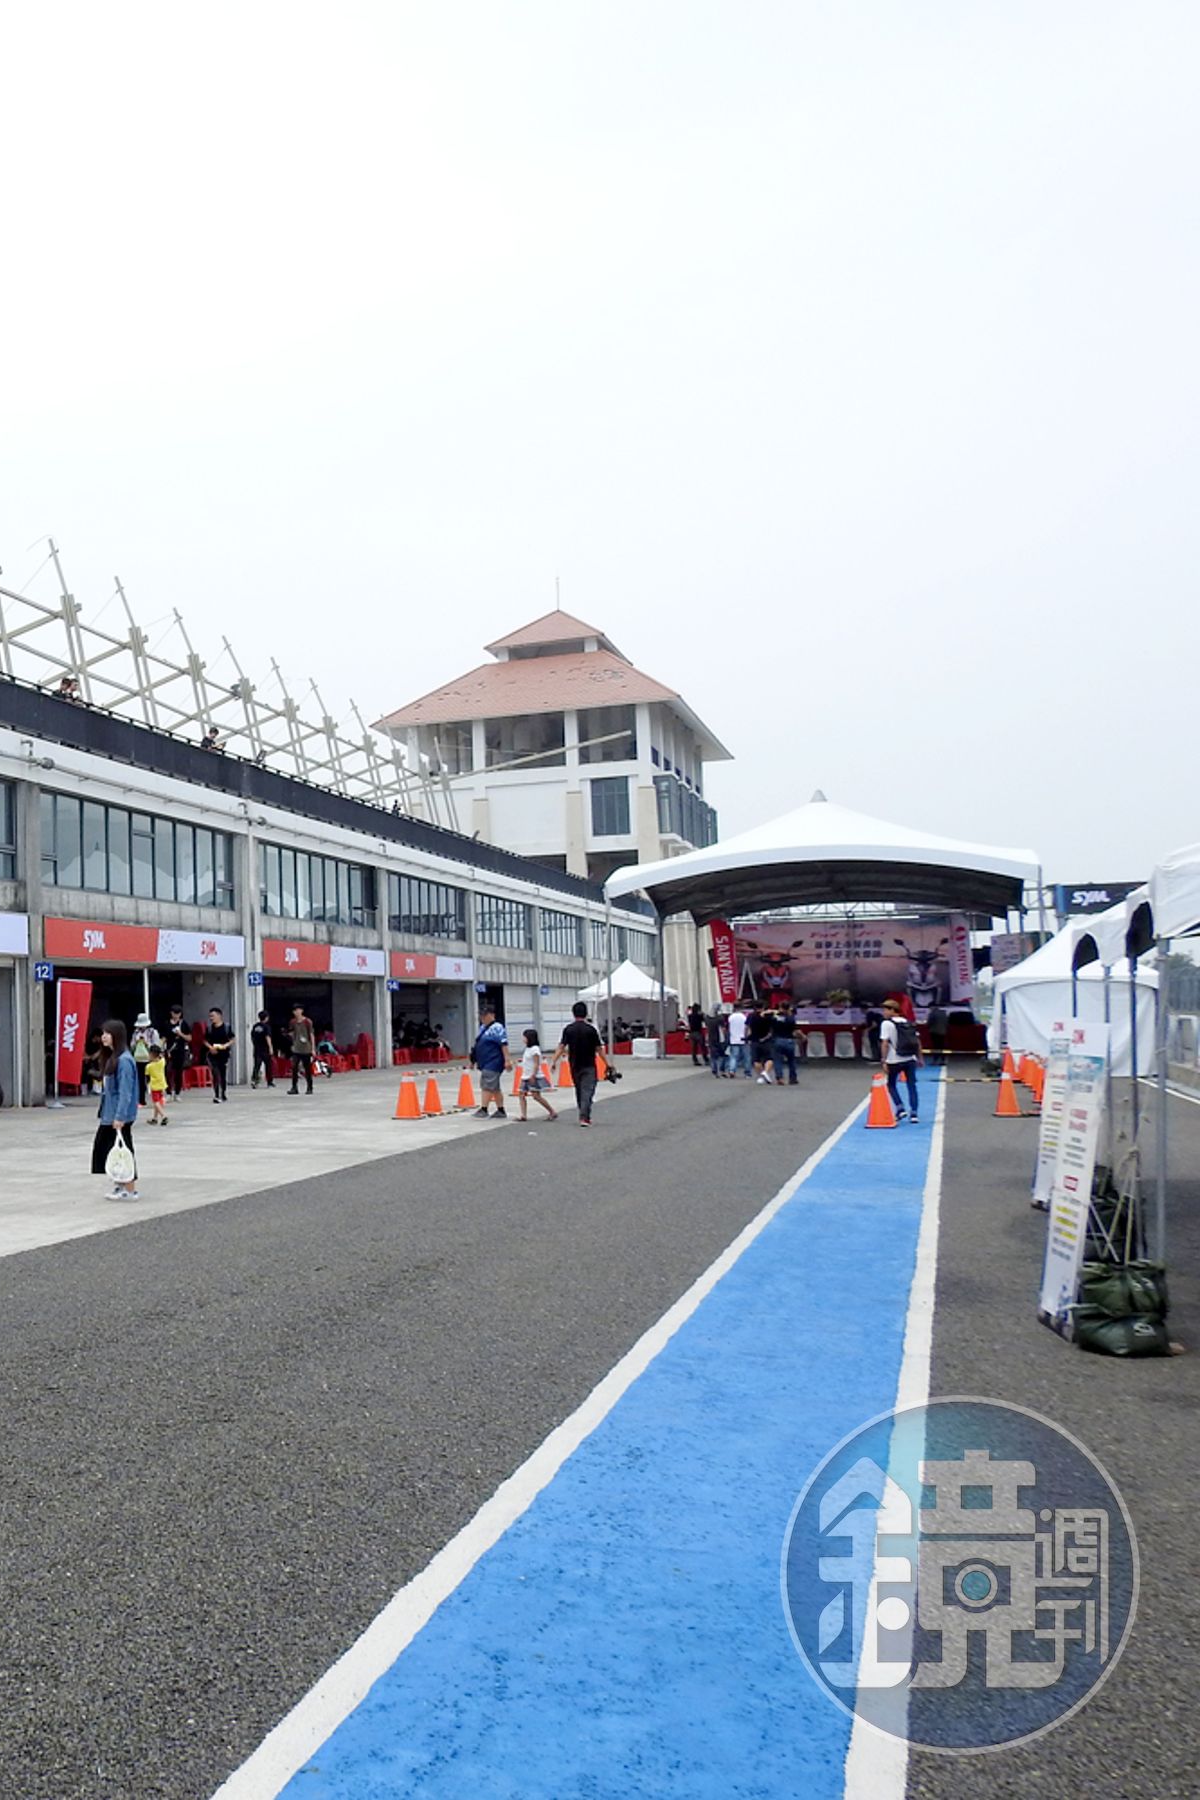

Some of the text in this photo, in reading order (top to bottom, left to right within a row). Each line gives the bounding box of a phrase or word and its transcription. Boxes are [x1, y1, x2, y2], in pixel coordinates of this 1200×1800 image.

[1071, 890, 1111, 906] SYM
[83, 929, 106, 953] SYM
[200, 940, 217, 959] SYM
[36, 966, 49, 979] 12
[715, 935, 735, 994] SANYANG
